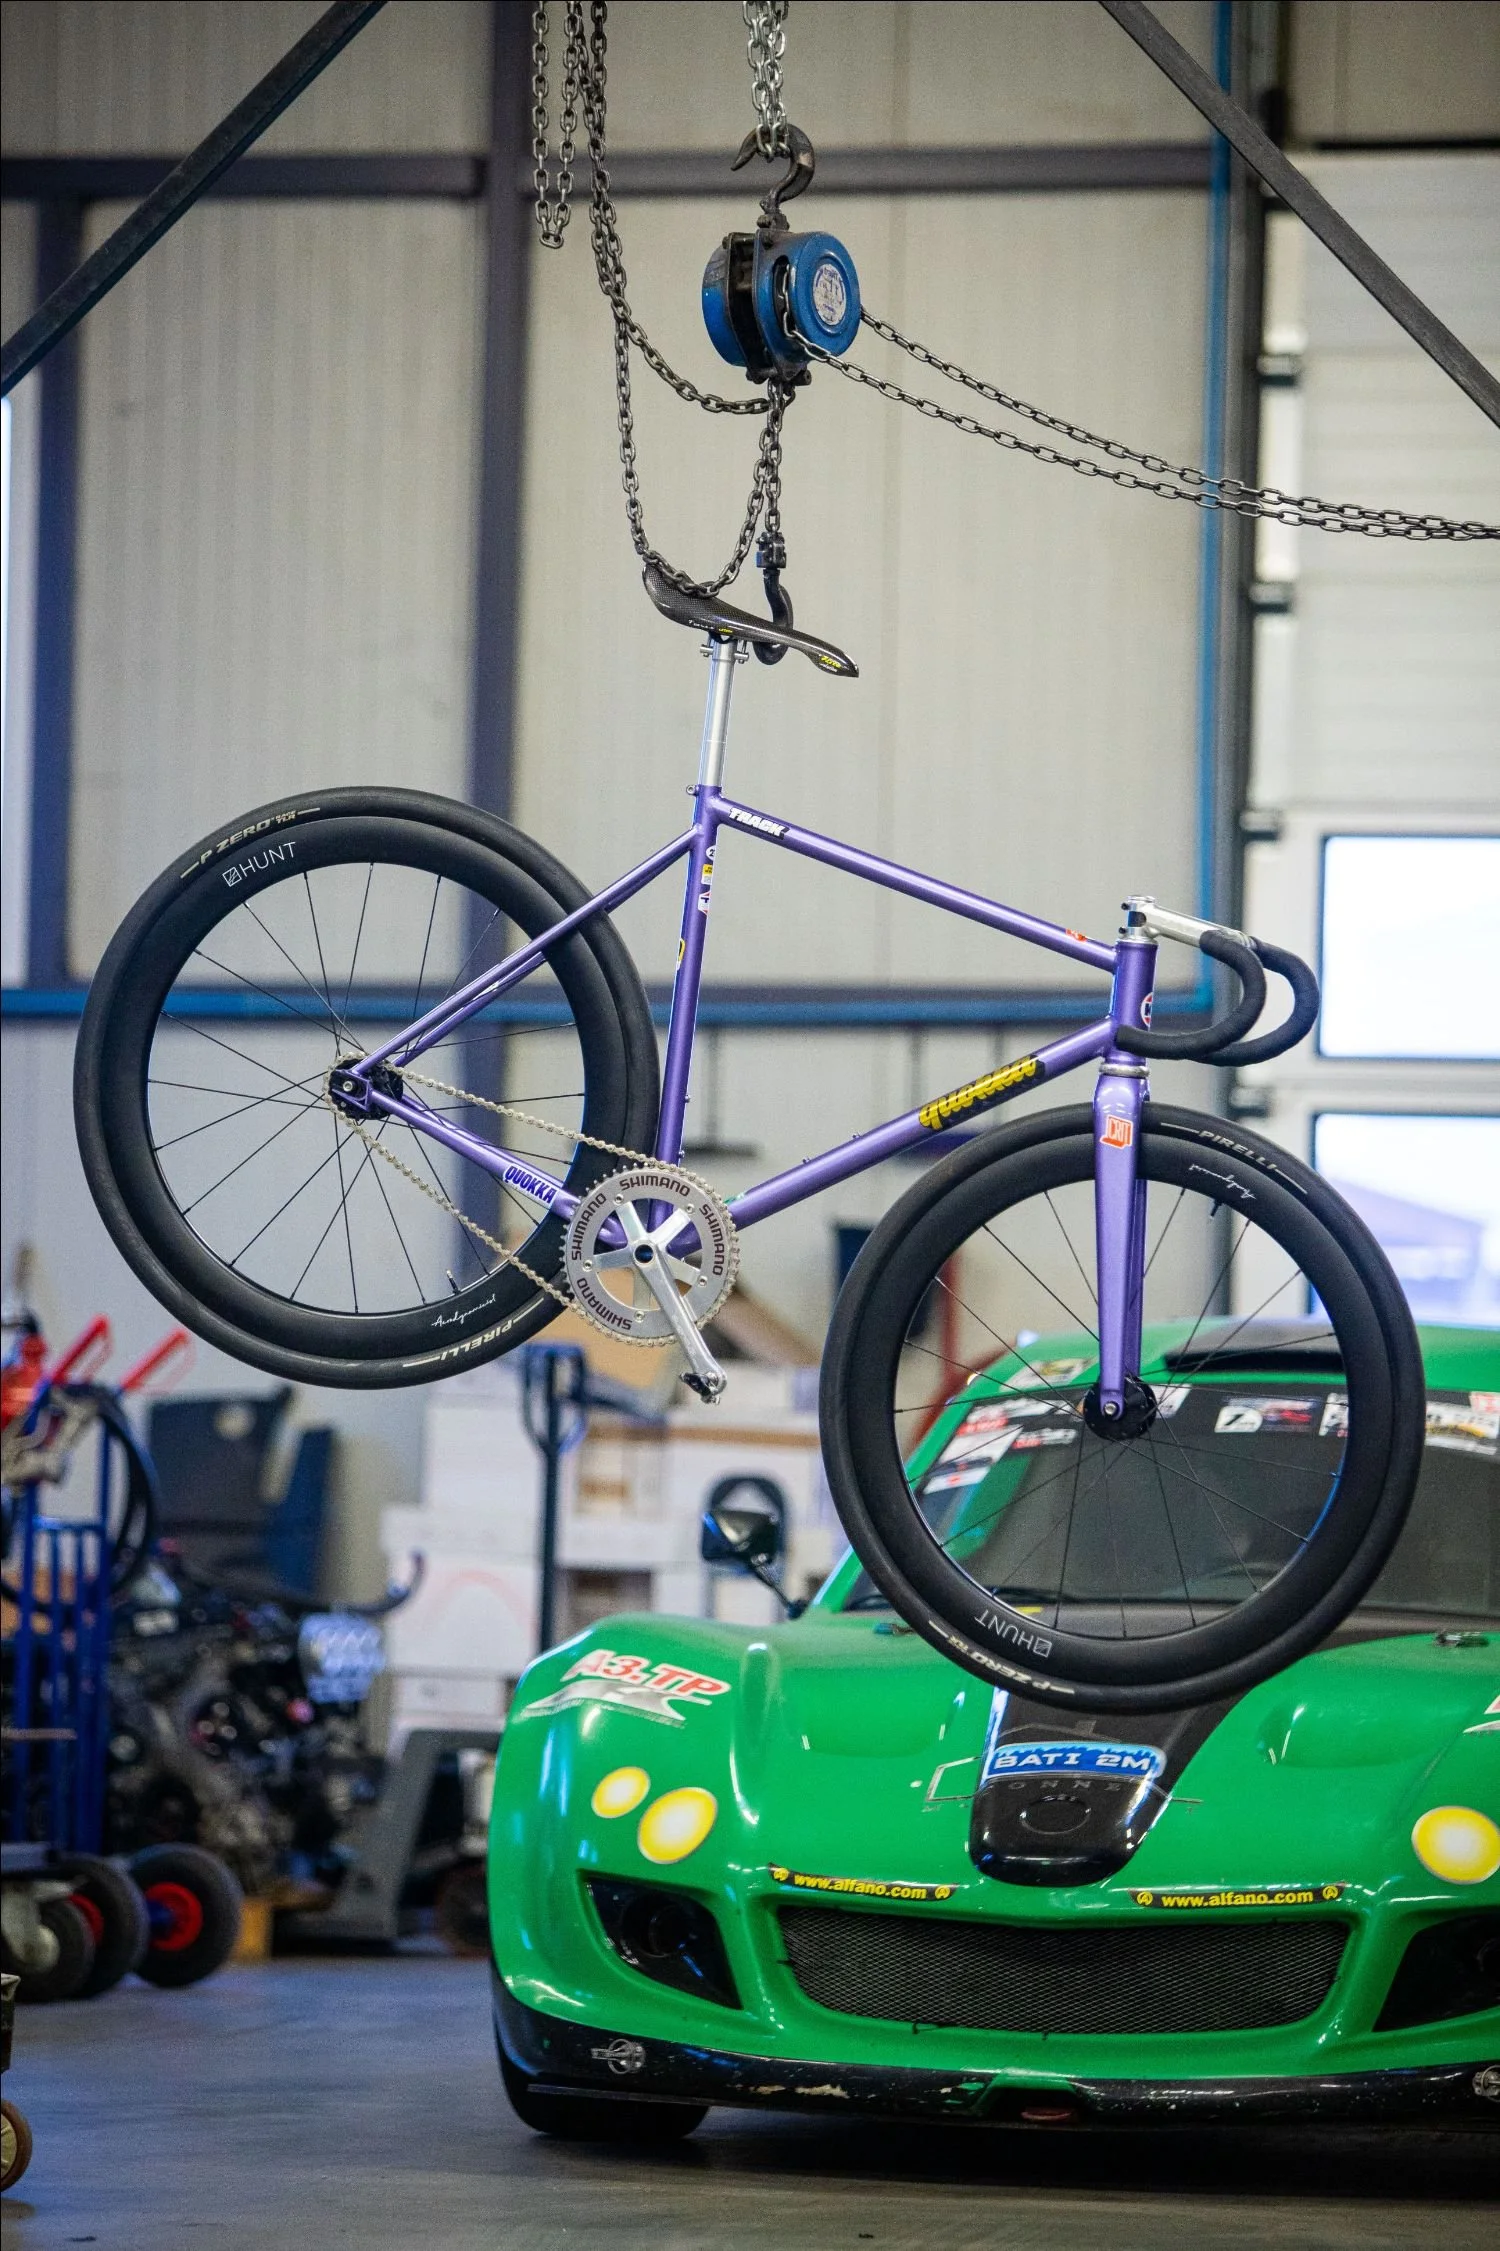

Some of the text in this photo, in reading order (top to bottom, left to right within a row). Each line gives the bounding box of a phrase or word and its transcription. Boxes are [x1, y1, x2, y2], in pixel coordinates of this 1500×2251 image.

[200, 849, 213, 865] P
[216, 818, 271, 854] ZERO
[729, 807, 788, 839] TRACK
[239, 841, 296, 878] HUNT
[1199, 1130, 1278, 1169] PIRELLI
[504, 1165, 558, 1204] QUOKKA
[619, 1175, 691, 1198] SHIMANO
[571, 1192, 607, 1261] SHIMANO
[699, 1203, 725, 1276] SHIMANO
[577, 1277, 633, 1331] SHIMANO
[440, 1319, 513, 1361] PIRELLI
[974, 1609, 1034, 1650] HUNT
[561, 1650, 732, 1697] A3.TP
[970, 1651, 1032, 1684] ZERO
[994, 1752, 1151, 1770] BATI 2M
[794, 1874, 927, 1899] www.alfano.com
[1161, 1891, 1313, 1907] www.alfano.com
